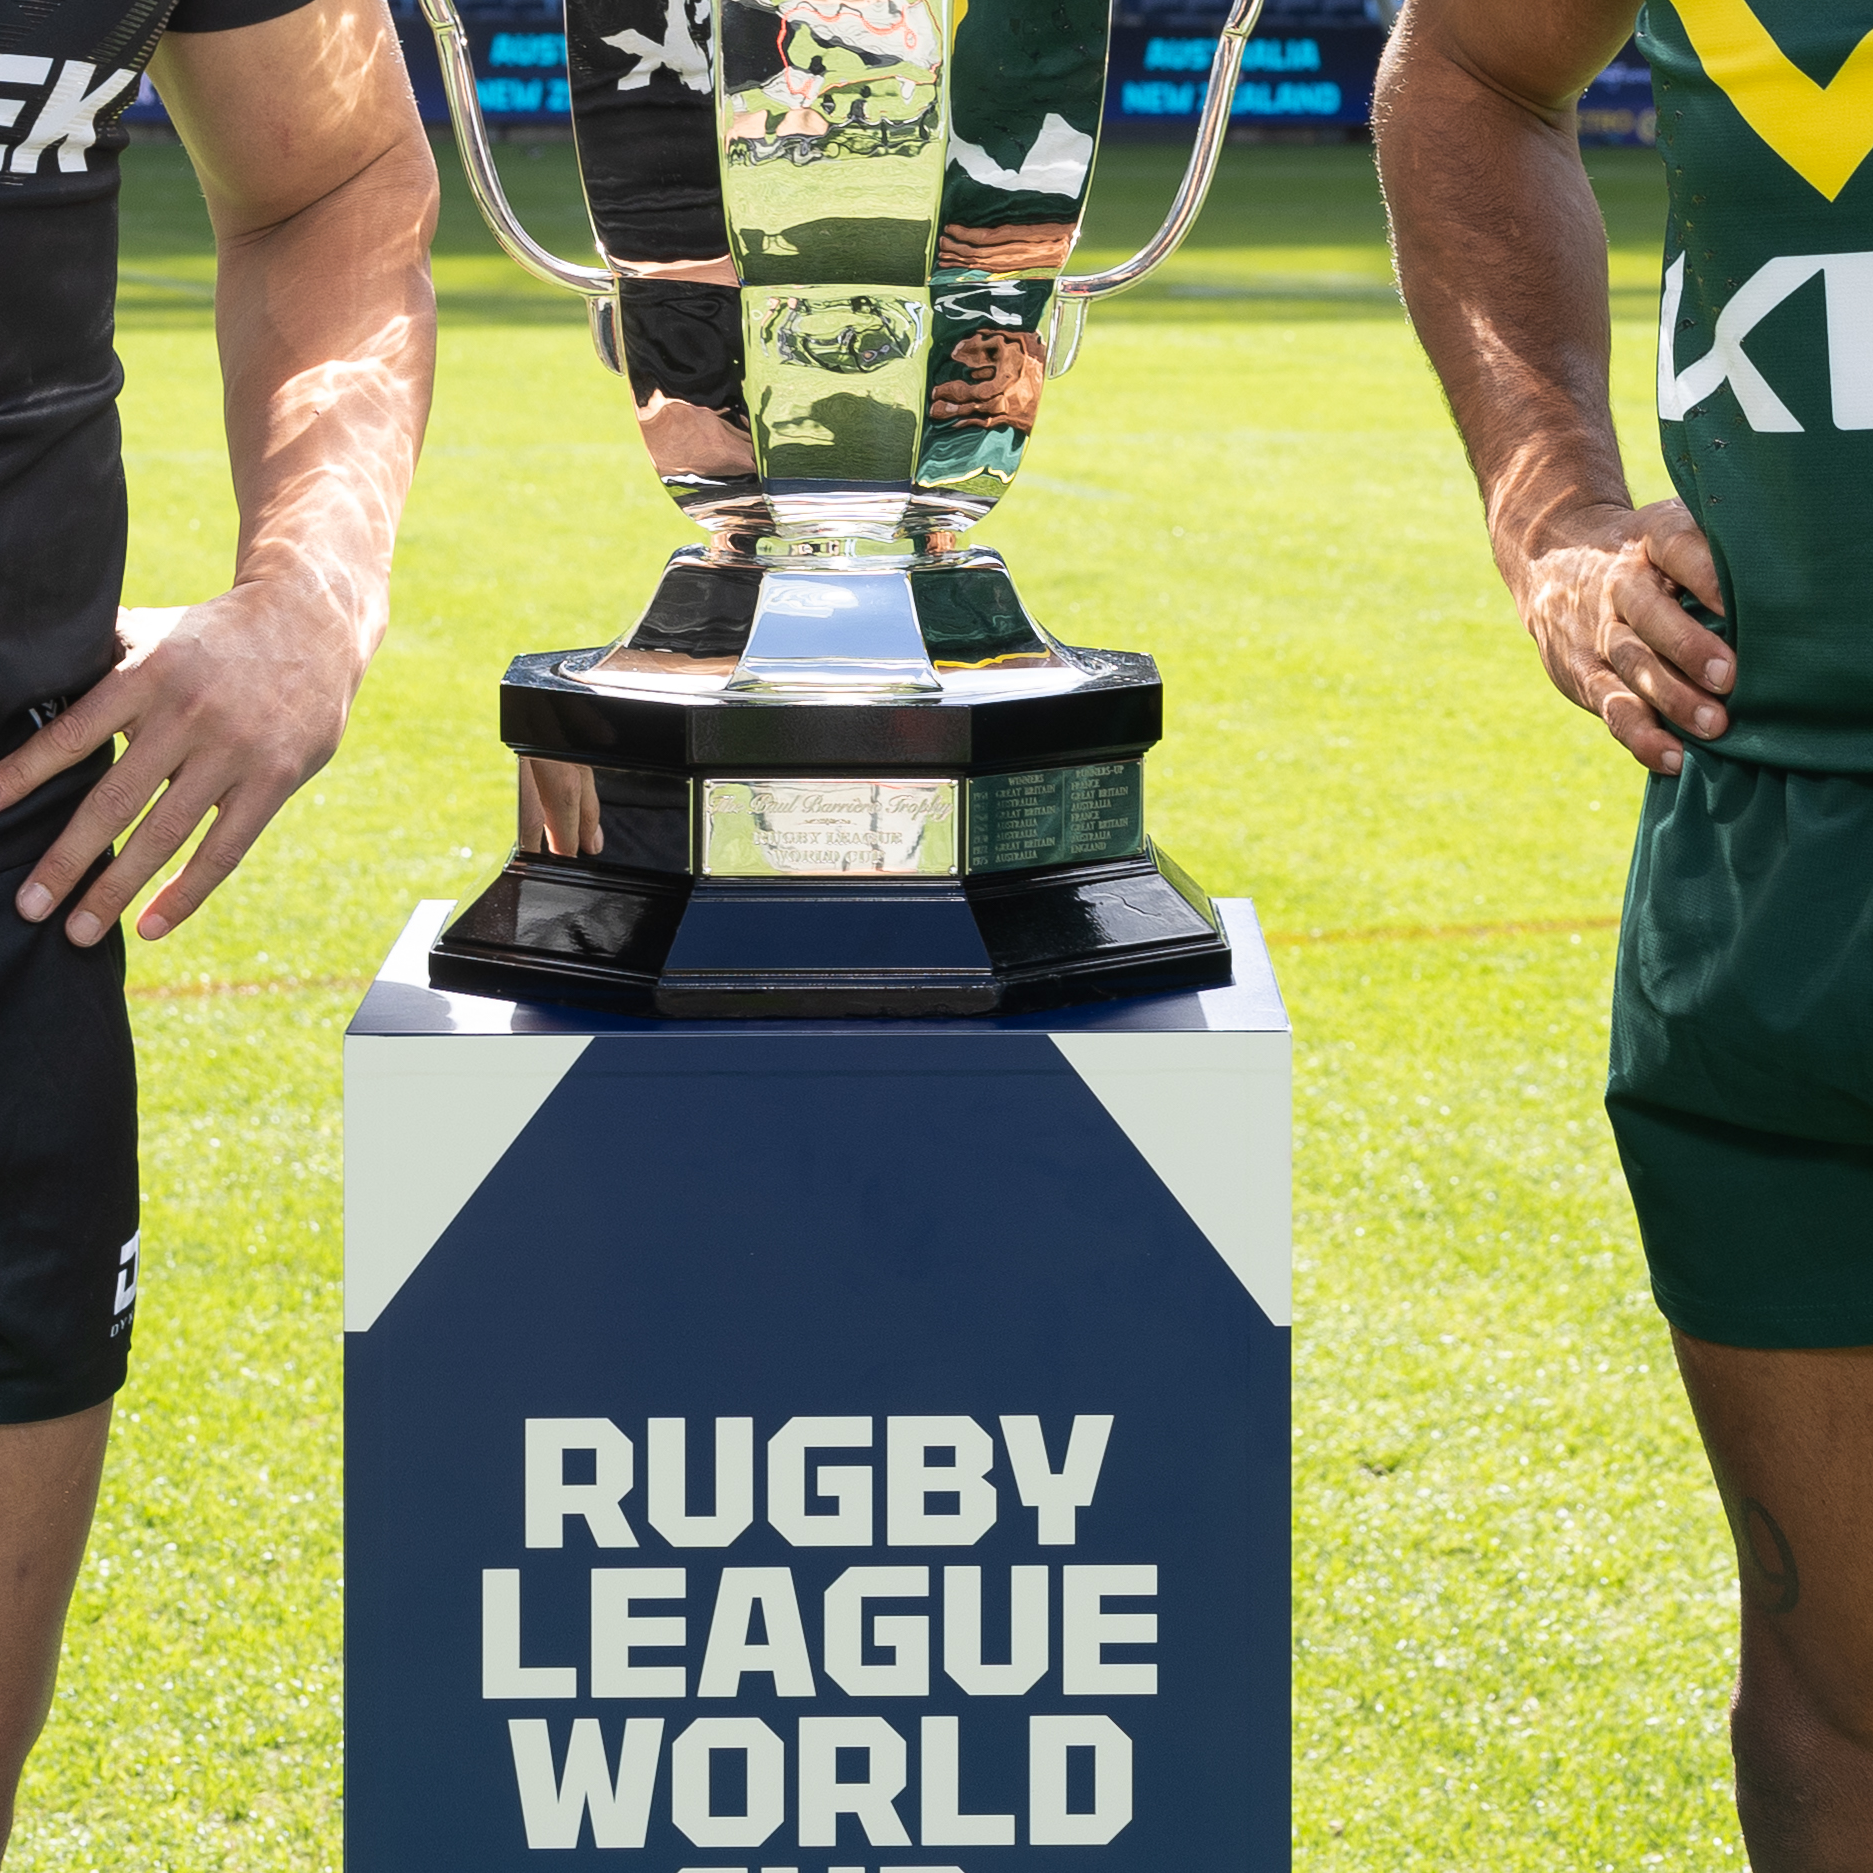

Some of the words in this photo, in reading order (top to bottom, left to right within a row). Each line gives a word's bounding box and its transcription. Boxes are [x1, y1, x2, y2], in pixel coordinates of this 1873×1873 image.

[1144, 37, 1321, 72] AUSALIA
[1197, 82, 1341, 115] ALAND
[708, 795, 744, 814] The
[747, 793, 796, 815] Paul
[885, 793, 955, 823] Trophy
[753, 831, 822, 845] RUGBY
[826, 831, 904, 845] LEAGUE
[774, 849, 840, 864] WORLD
[842, 849, 886, 864] CUP
[995, 850, 1038, 863] AUSTRALIA
[524, 1414, 1115, 1548] RUGBY
[481, 1564, 1159, 1699] LEAGUE
[507, 1715, 1133, 1849] WORLD
